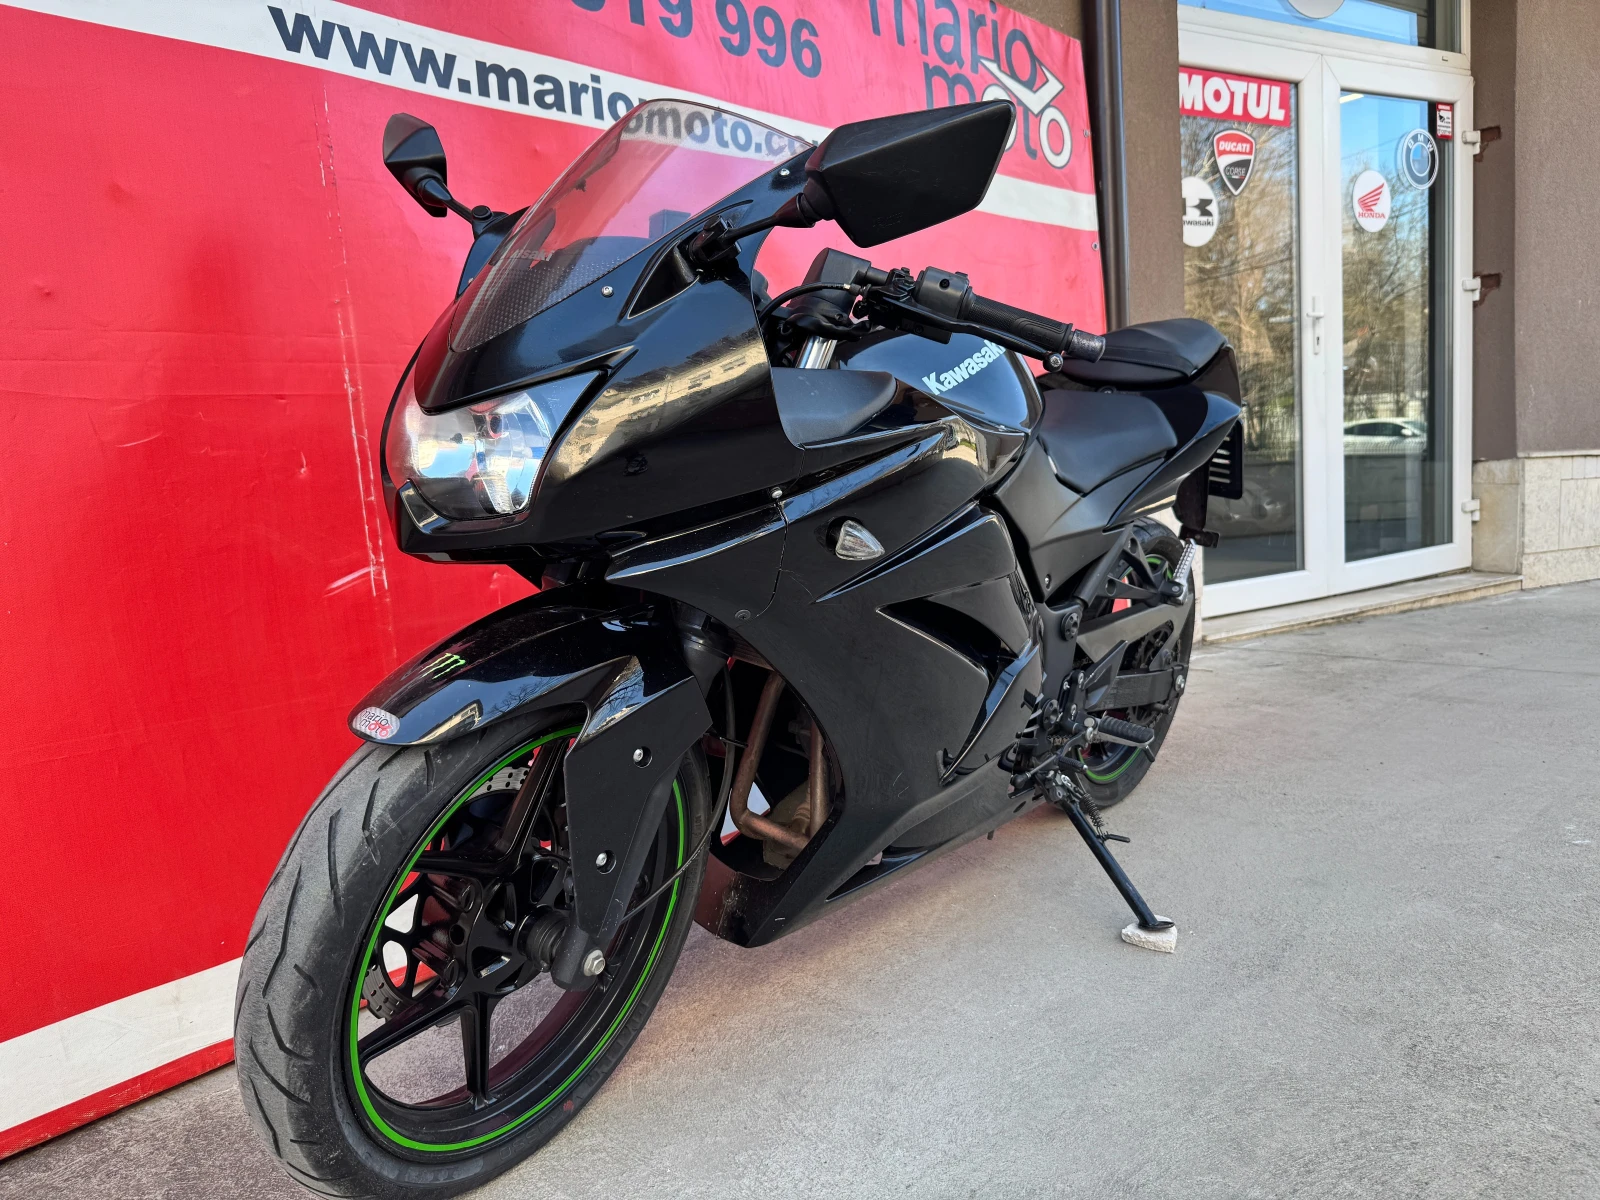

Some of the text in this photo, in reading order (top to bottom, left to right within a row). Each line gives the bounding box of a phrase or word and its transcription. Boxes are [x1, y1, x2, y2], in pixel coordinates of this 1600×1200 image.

[715, 0, 821, 78] 996
[267, 6, 818, 158] www.mariomoto.co
[1179, 72, 1285, 121] MOTUL
[1218, 140, 1251, 153] DUCATI
[1407, 133, 1434, 152] BMW
[1225, 166, 1246, 176] CORSE
[1183, 219, 1214, 227] wasaki
[921, 339, 1006, 396] Kawasaki
[361, 710, 389, 726] mario
